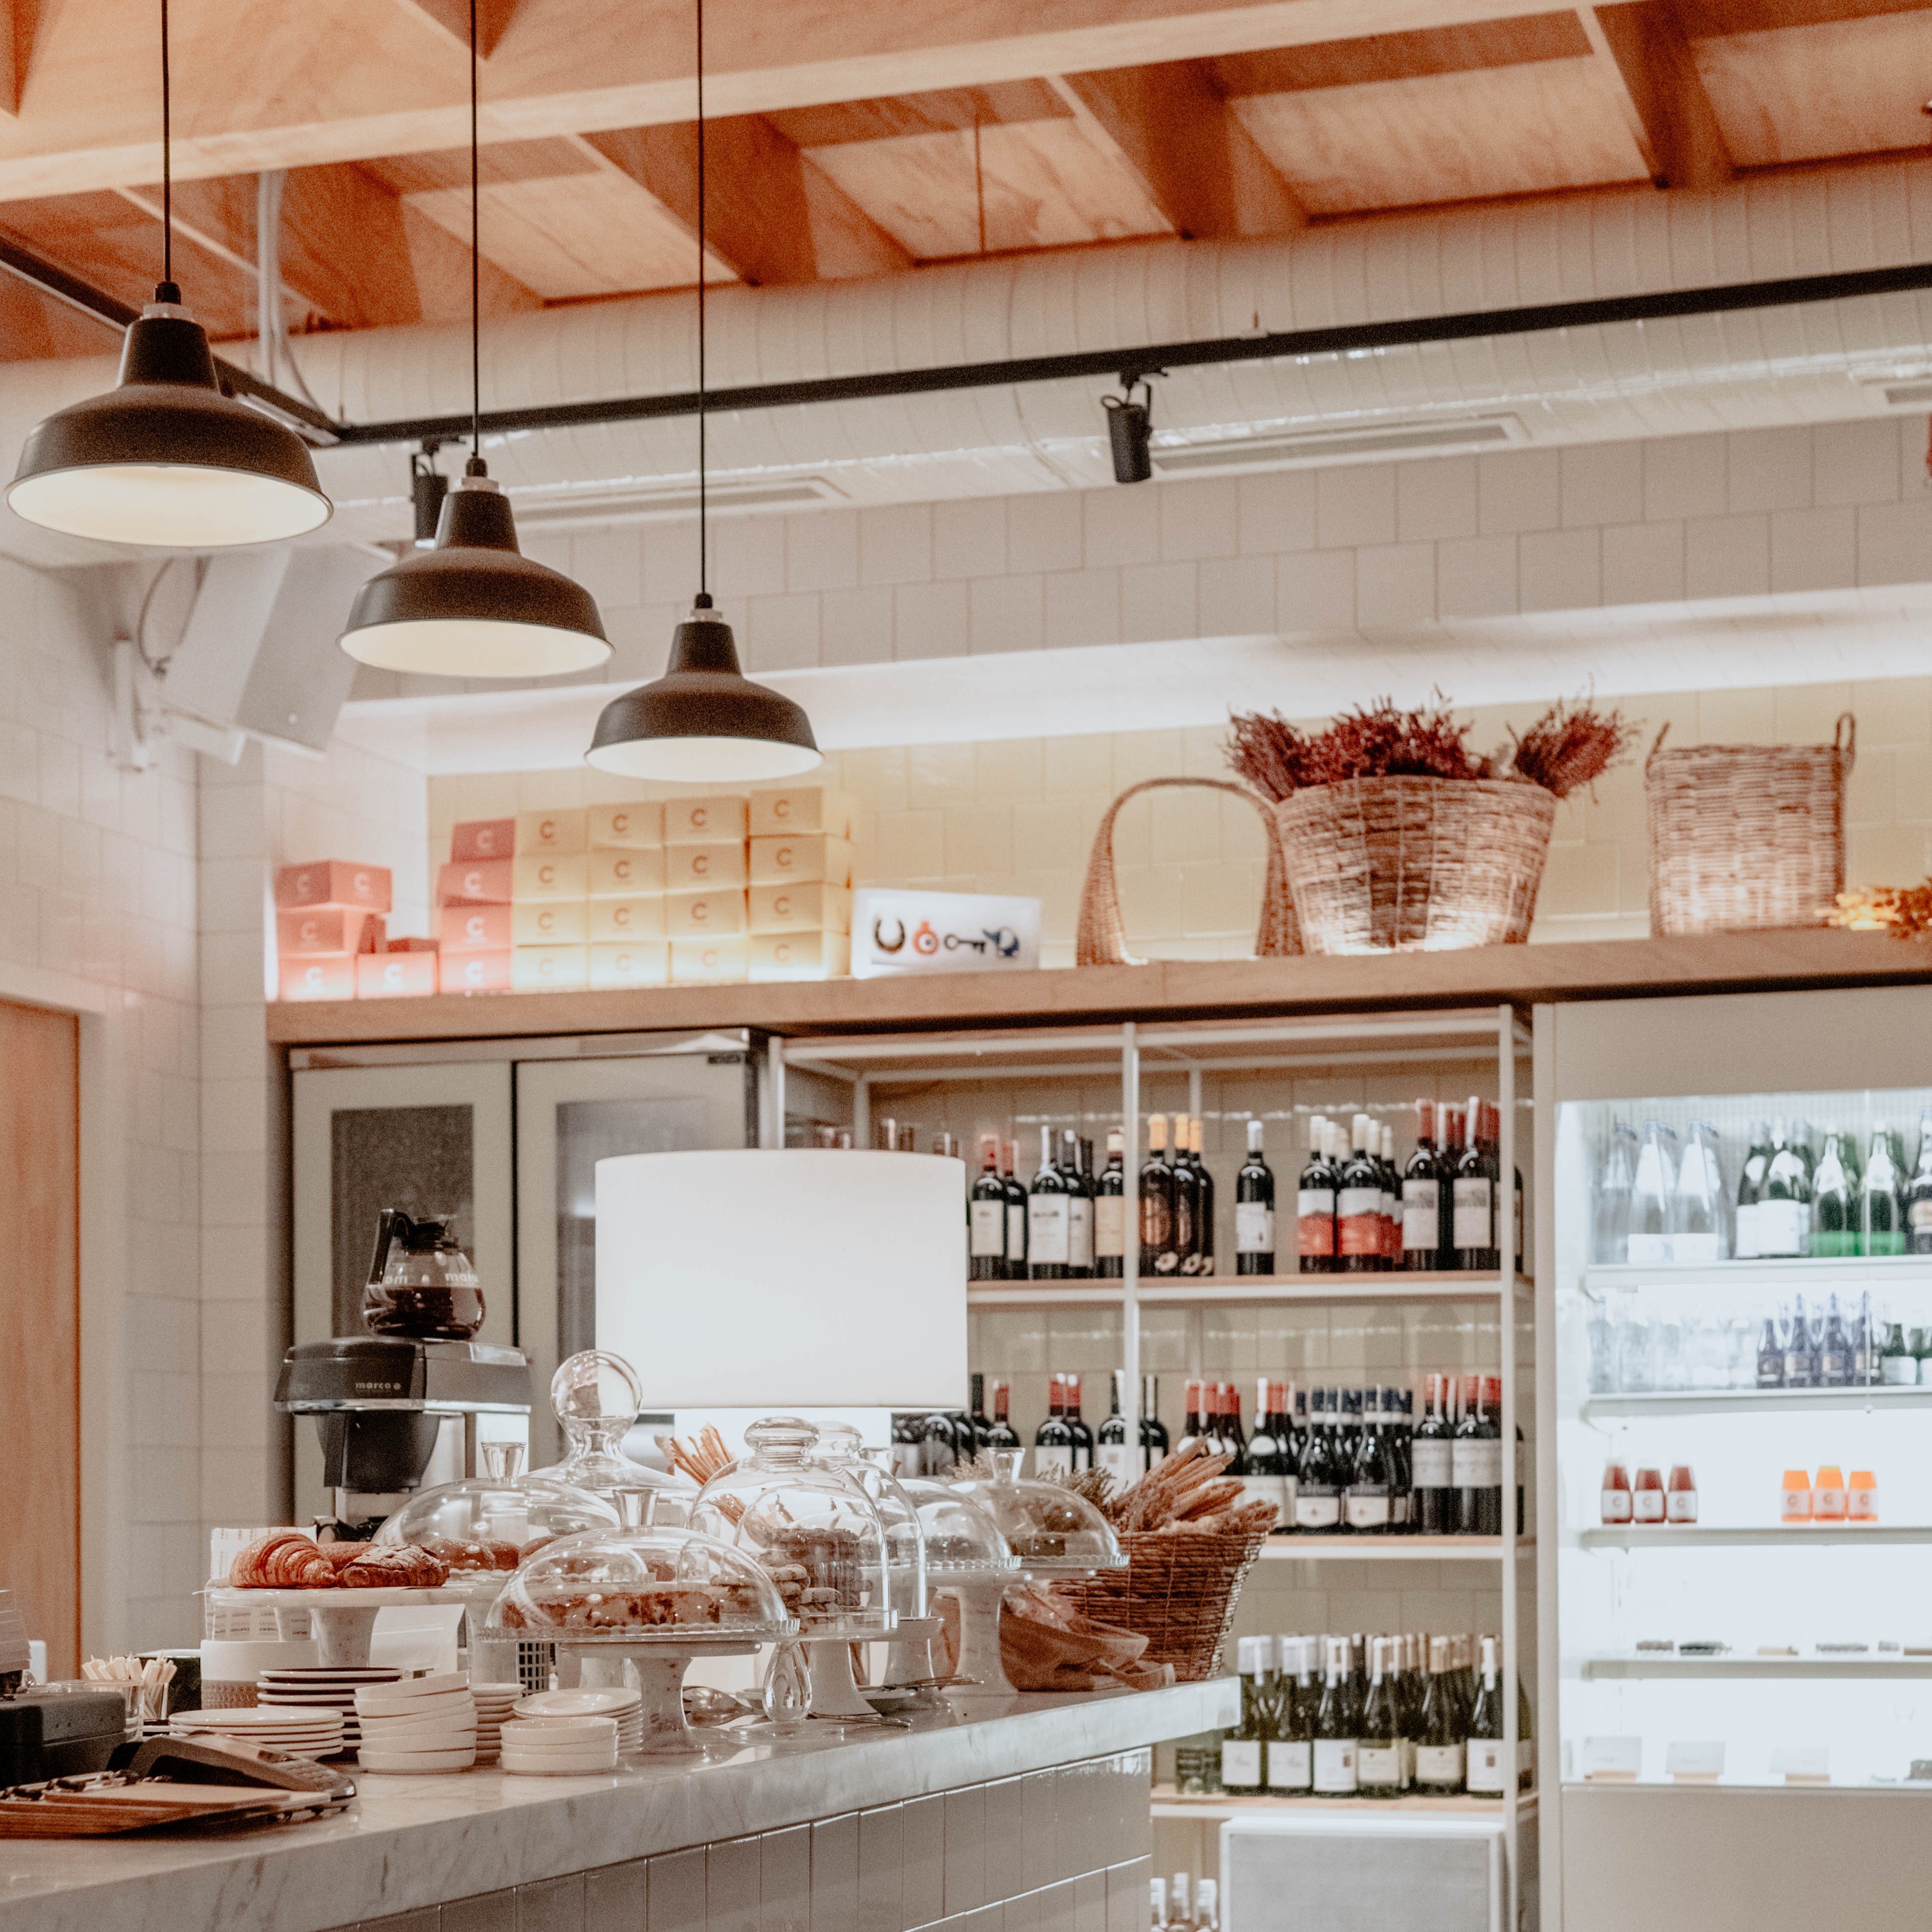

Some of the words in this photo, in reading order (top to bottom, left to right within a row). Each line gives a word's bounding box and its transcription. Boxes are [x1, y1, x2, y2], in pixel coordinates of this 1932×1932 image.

[691, 808, 706, 826] C
[774, 800, 789, 818] C
[540, 821, 554, 839] C
[613, 814, 628, 831] C
[477, 830, 493, 848] C
[693, 855, 708, 873] C
[776, 848, 791, 866] C
[538, 865, 553, 884] C
[615, 860, 630, 878] C
[354, 873, 370, 892] C
[465, 872, 481, 891] C
[691, 902, 707, 921] C
[774, 897, 790, 914] C
[538, 912, 553, 930] C
[614, 907, 629, 926] C
[301, 921, 317, 940] C
[467, 917, 484, 937] C
[702, 950, 717, 967] C
[774, 945, 790, 962] C
[305, 967, 322, 986] C
[386, 964, 402, 983] C
[466, 962, 483, 981] C
